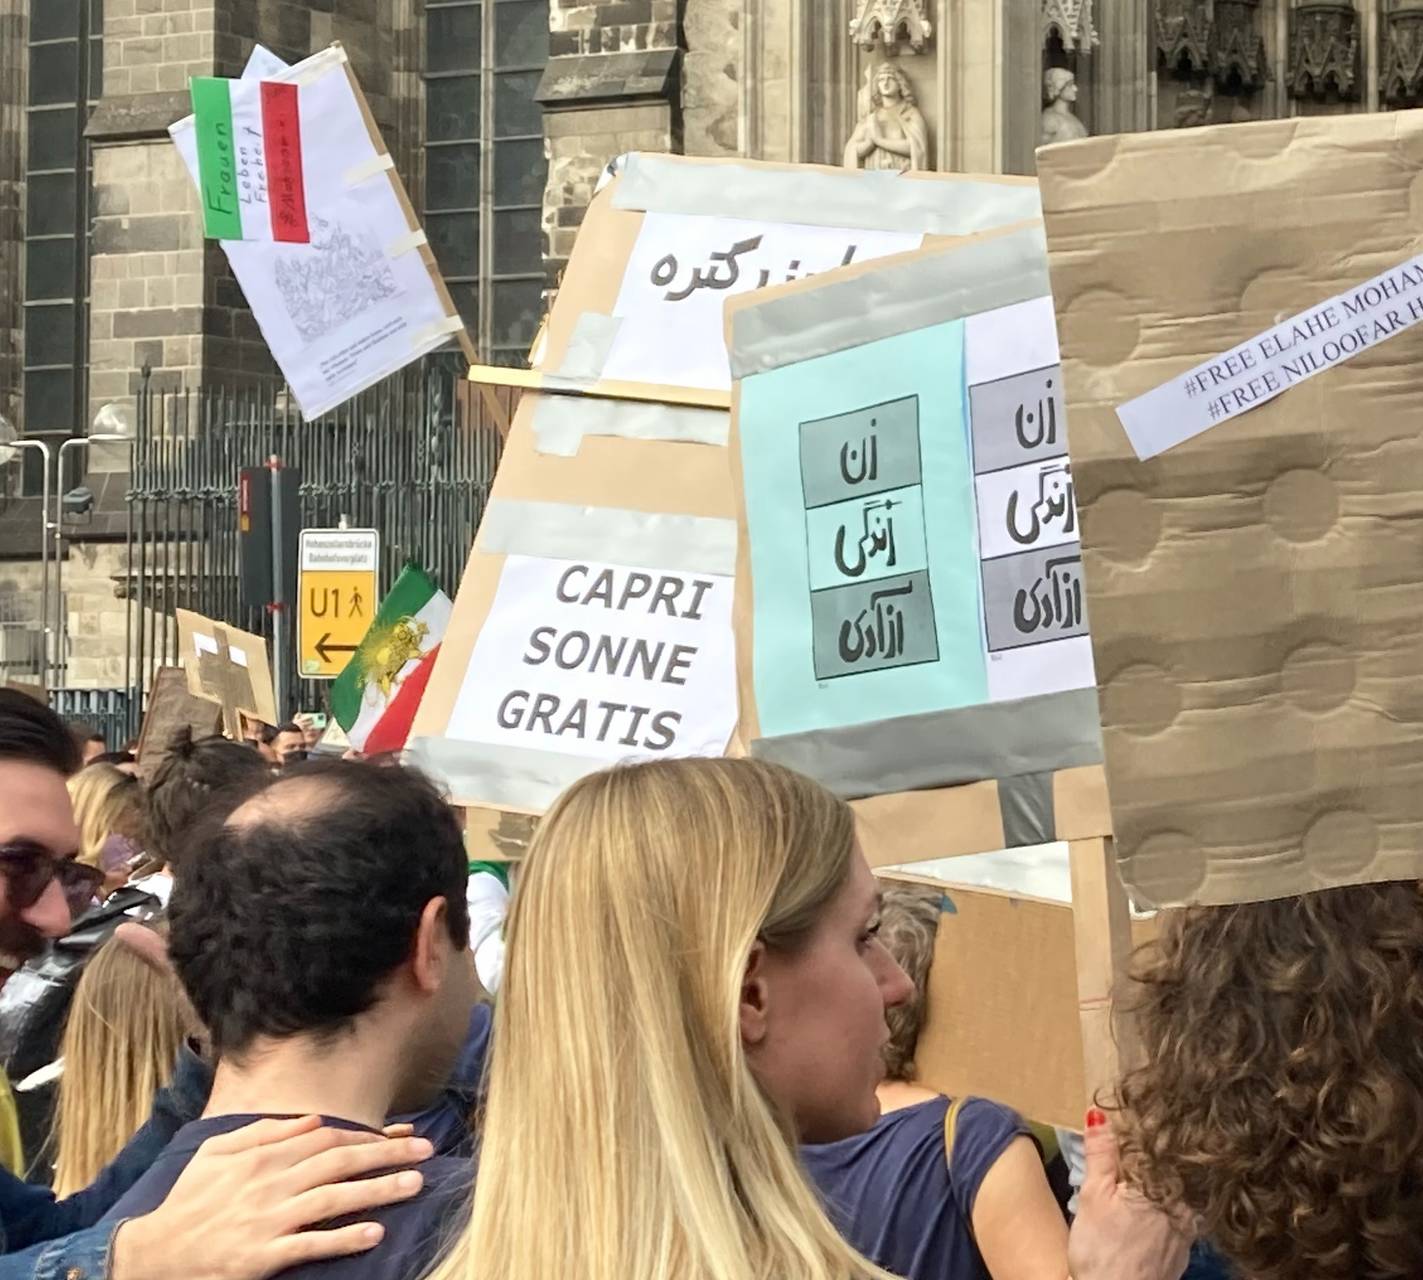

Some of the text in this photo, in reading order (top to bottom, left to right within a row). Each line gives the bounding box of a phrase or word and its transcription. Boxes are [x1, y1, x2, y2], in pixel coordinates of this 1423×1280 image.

[207, 122, 232, 215] Frauen
[237, 146, 251, 204] Leben
[243, 126, 267, 203] Frehet
[1184, 348, 1257, 398] #FREE
[1259, 307, 1340, 360] ELAHE
[1208, 370, 1281, 421] #FREE
[1281, 310, 1407, 383] NILOOFAR
[1015, 379, 1056, 449] زن
[840, 418, 878, 484] زن
[310, 587, 339, 618] U1
[556, 565, 714, 620] CAPRI
[522, 626, 699, 685] SONNE
[496, 689, 682, 751] GRATIS
